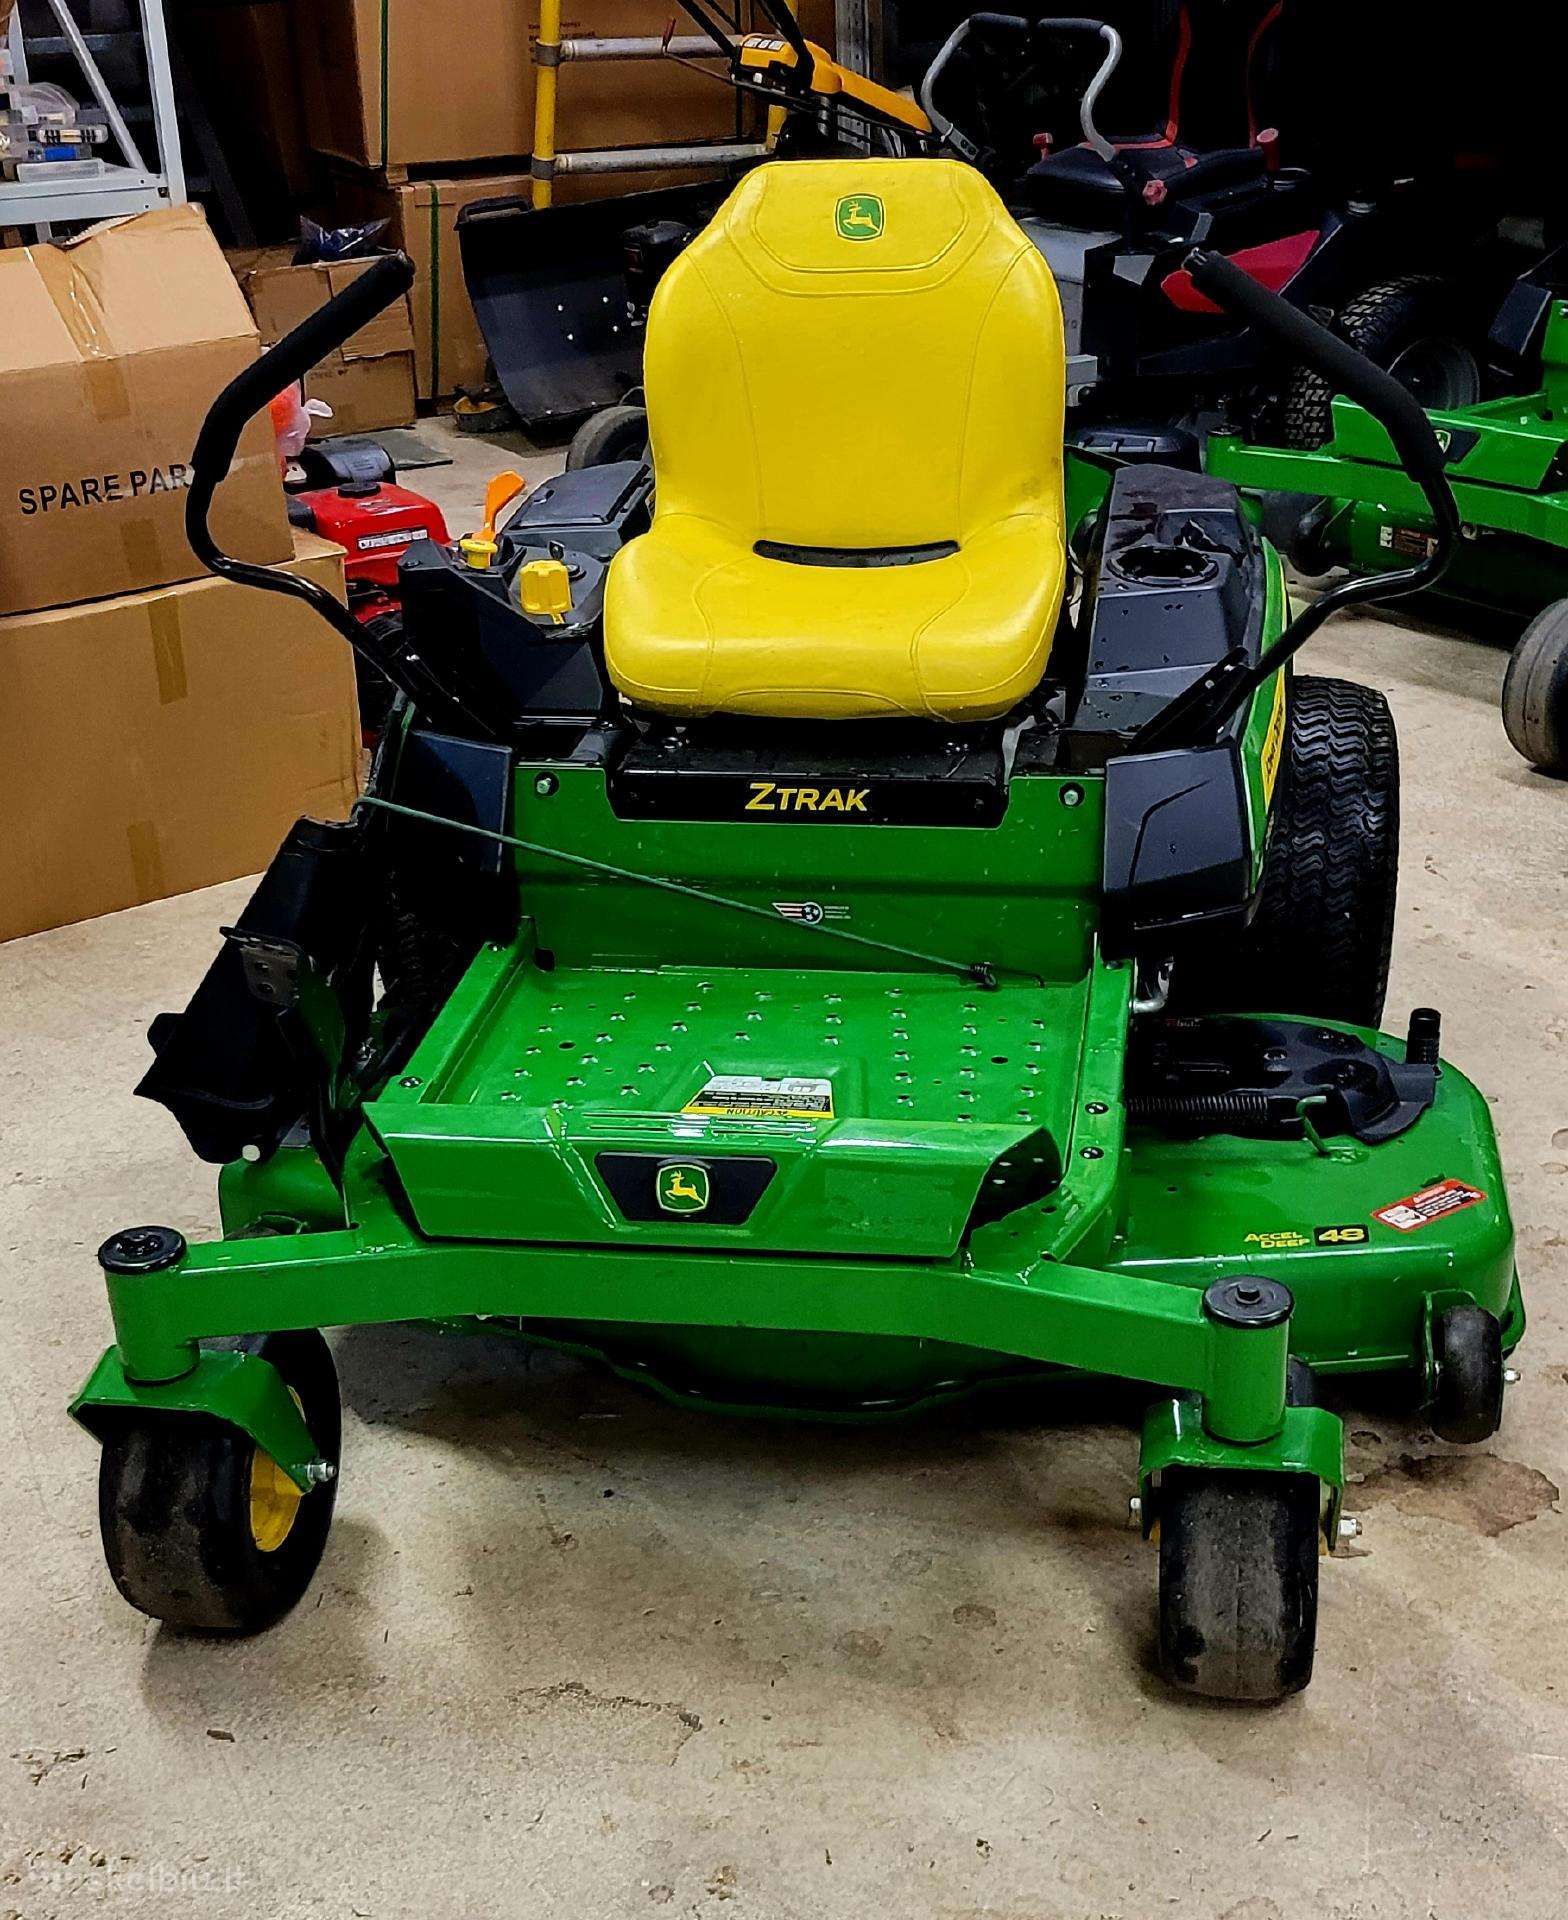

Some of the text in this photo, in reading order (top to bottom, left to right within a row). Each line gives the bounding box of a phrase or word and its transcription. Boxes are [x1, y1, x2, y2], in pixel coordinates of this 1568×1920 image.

[19, 463, 191, 515] SPARE PAR
[745, 783, 870, 812] ZTRAK
[1244, 1231, 1303, 1242] ACCEL
[1318, 1228, 1365, 1242] 48
[1260, 1238, 1310, 1249] DEEP
